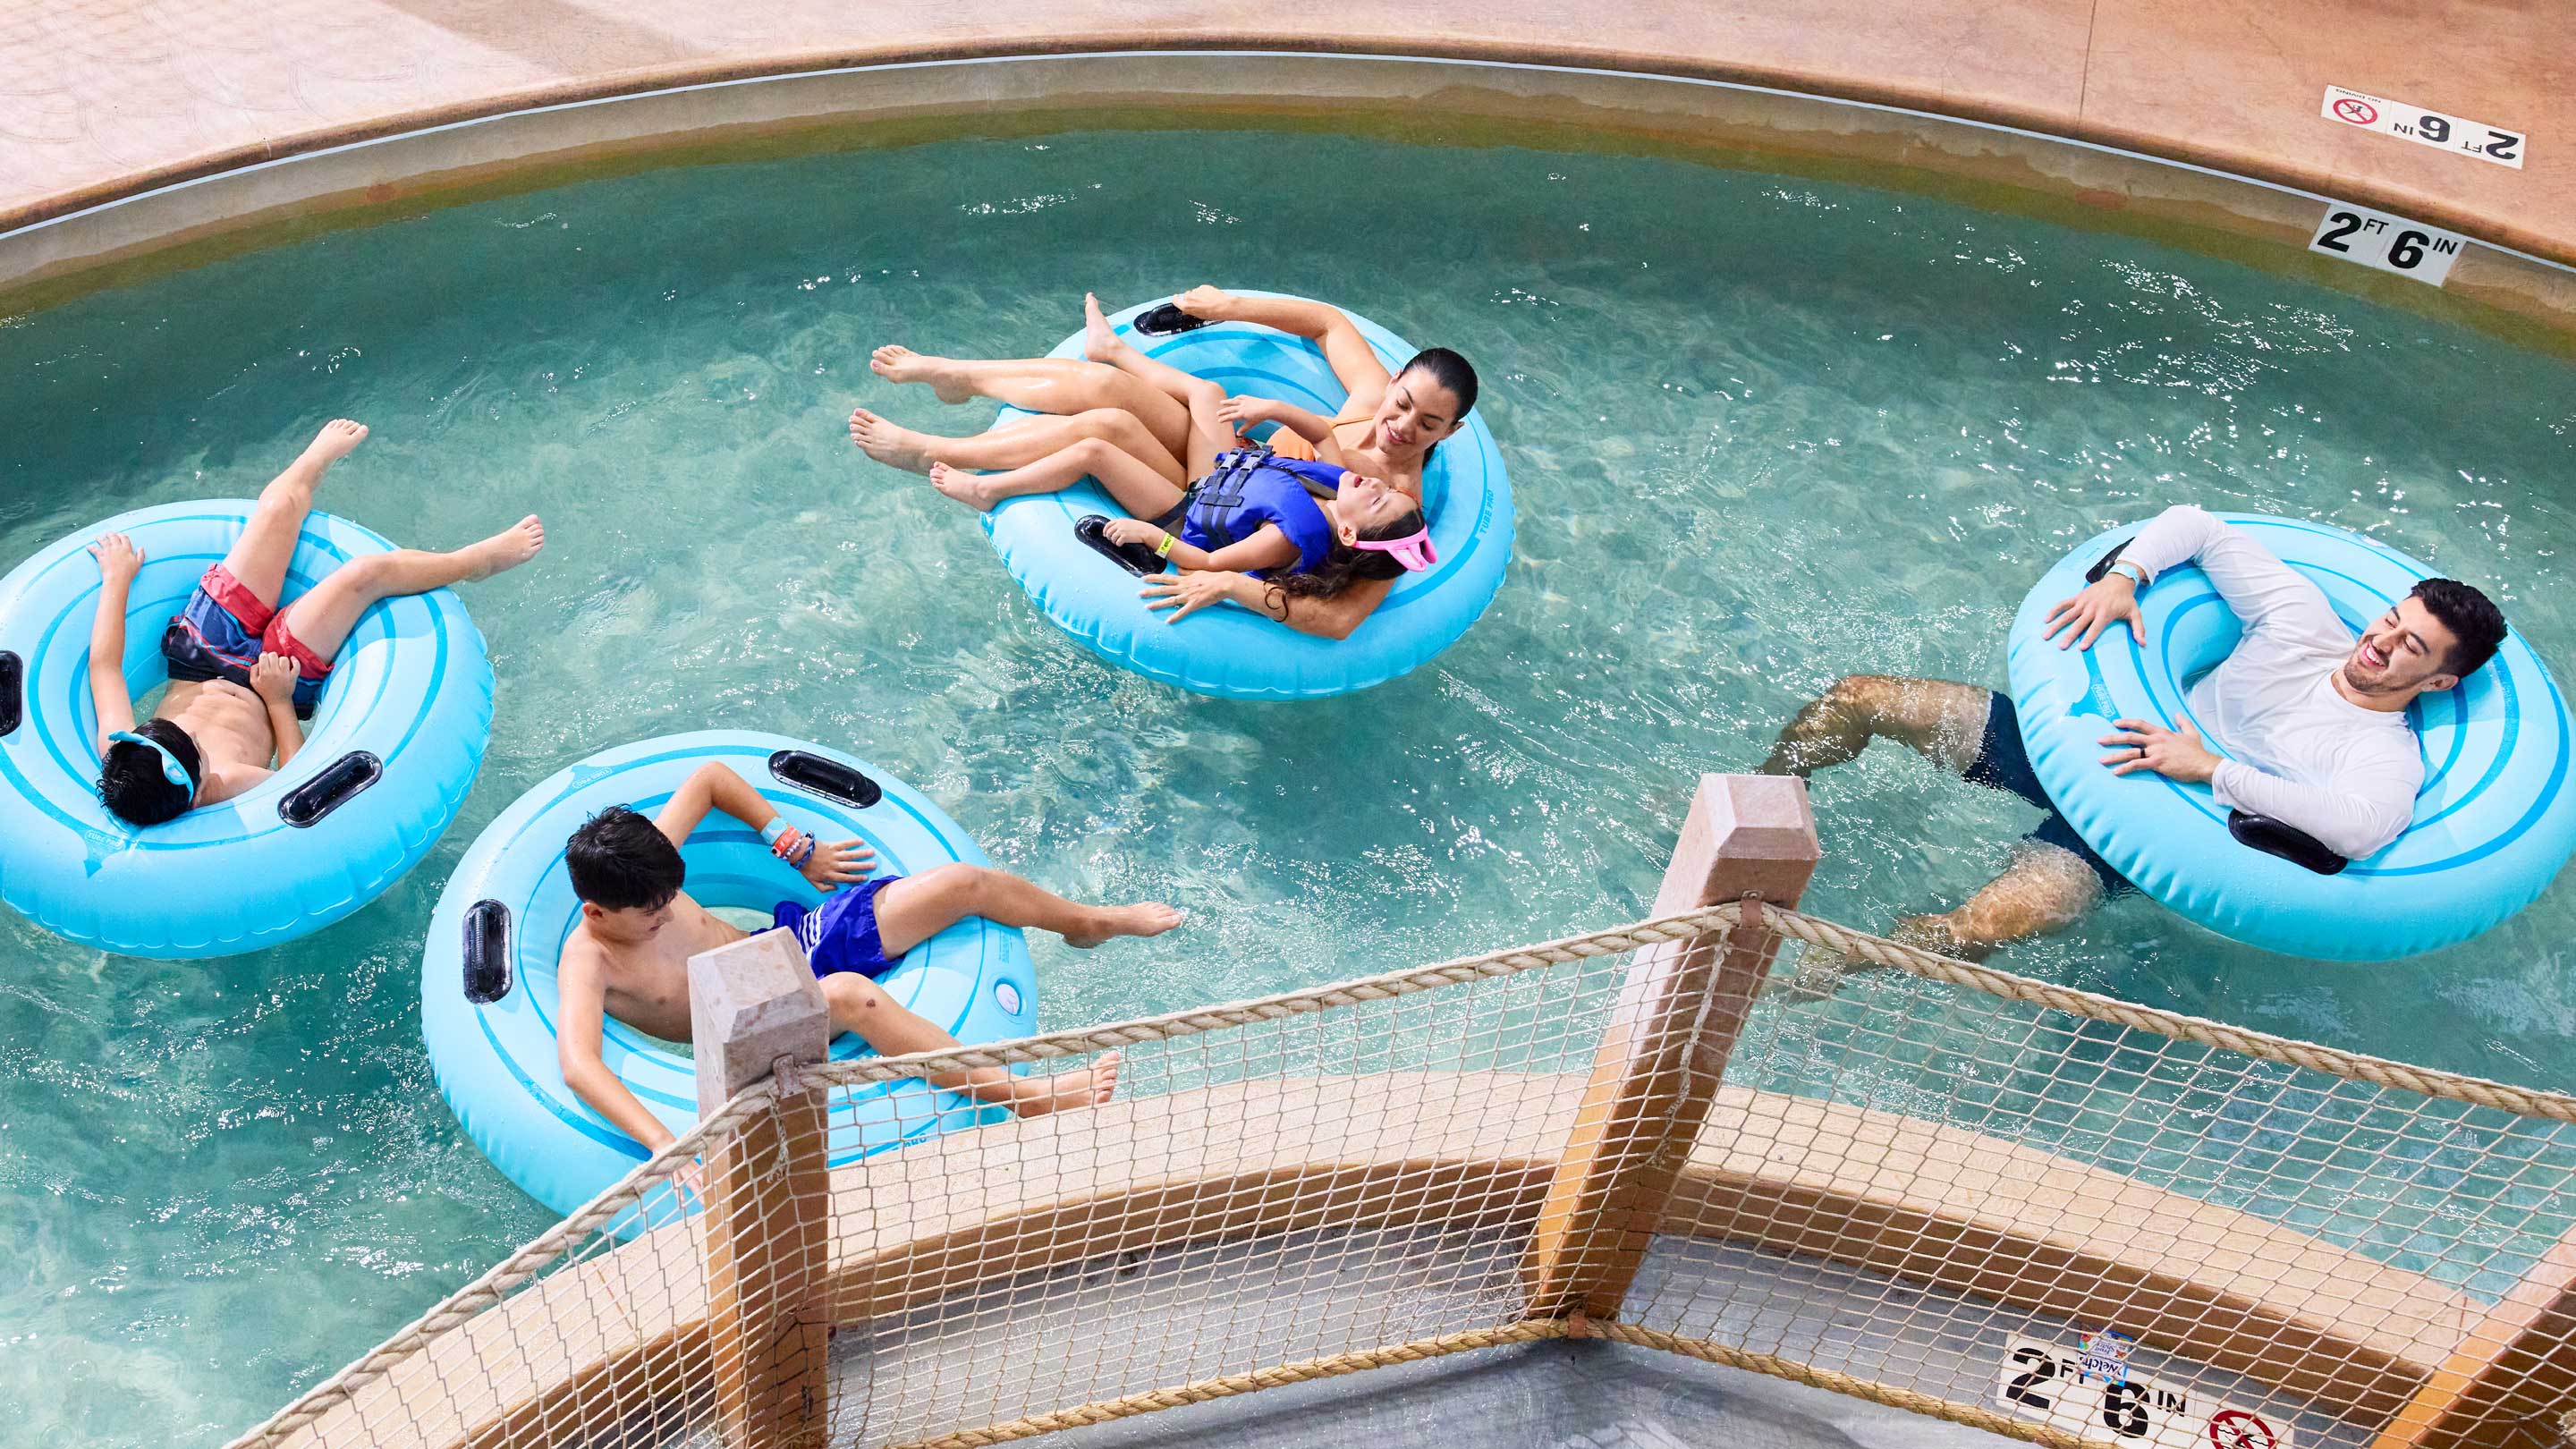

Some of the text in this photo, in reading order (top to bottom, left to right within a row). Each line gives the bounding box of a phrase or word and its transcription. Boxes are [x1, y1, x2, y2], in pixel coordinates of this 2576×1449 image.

[2393, 115, 2520, 160] 2 FT 6 IN
[2317, 211, 2459, 269] 2 FT 6 IN
[1479, 488, 1495, 534] TUBE PRO
[2006, 1347, 2055, 1410] 2
[2104, 1381, 2151, 1438] 6
[2157, 1389, 2187, 1418] IN
